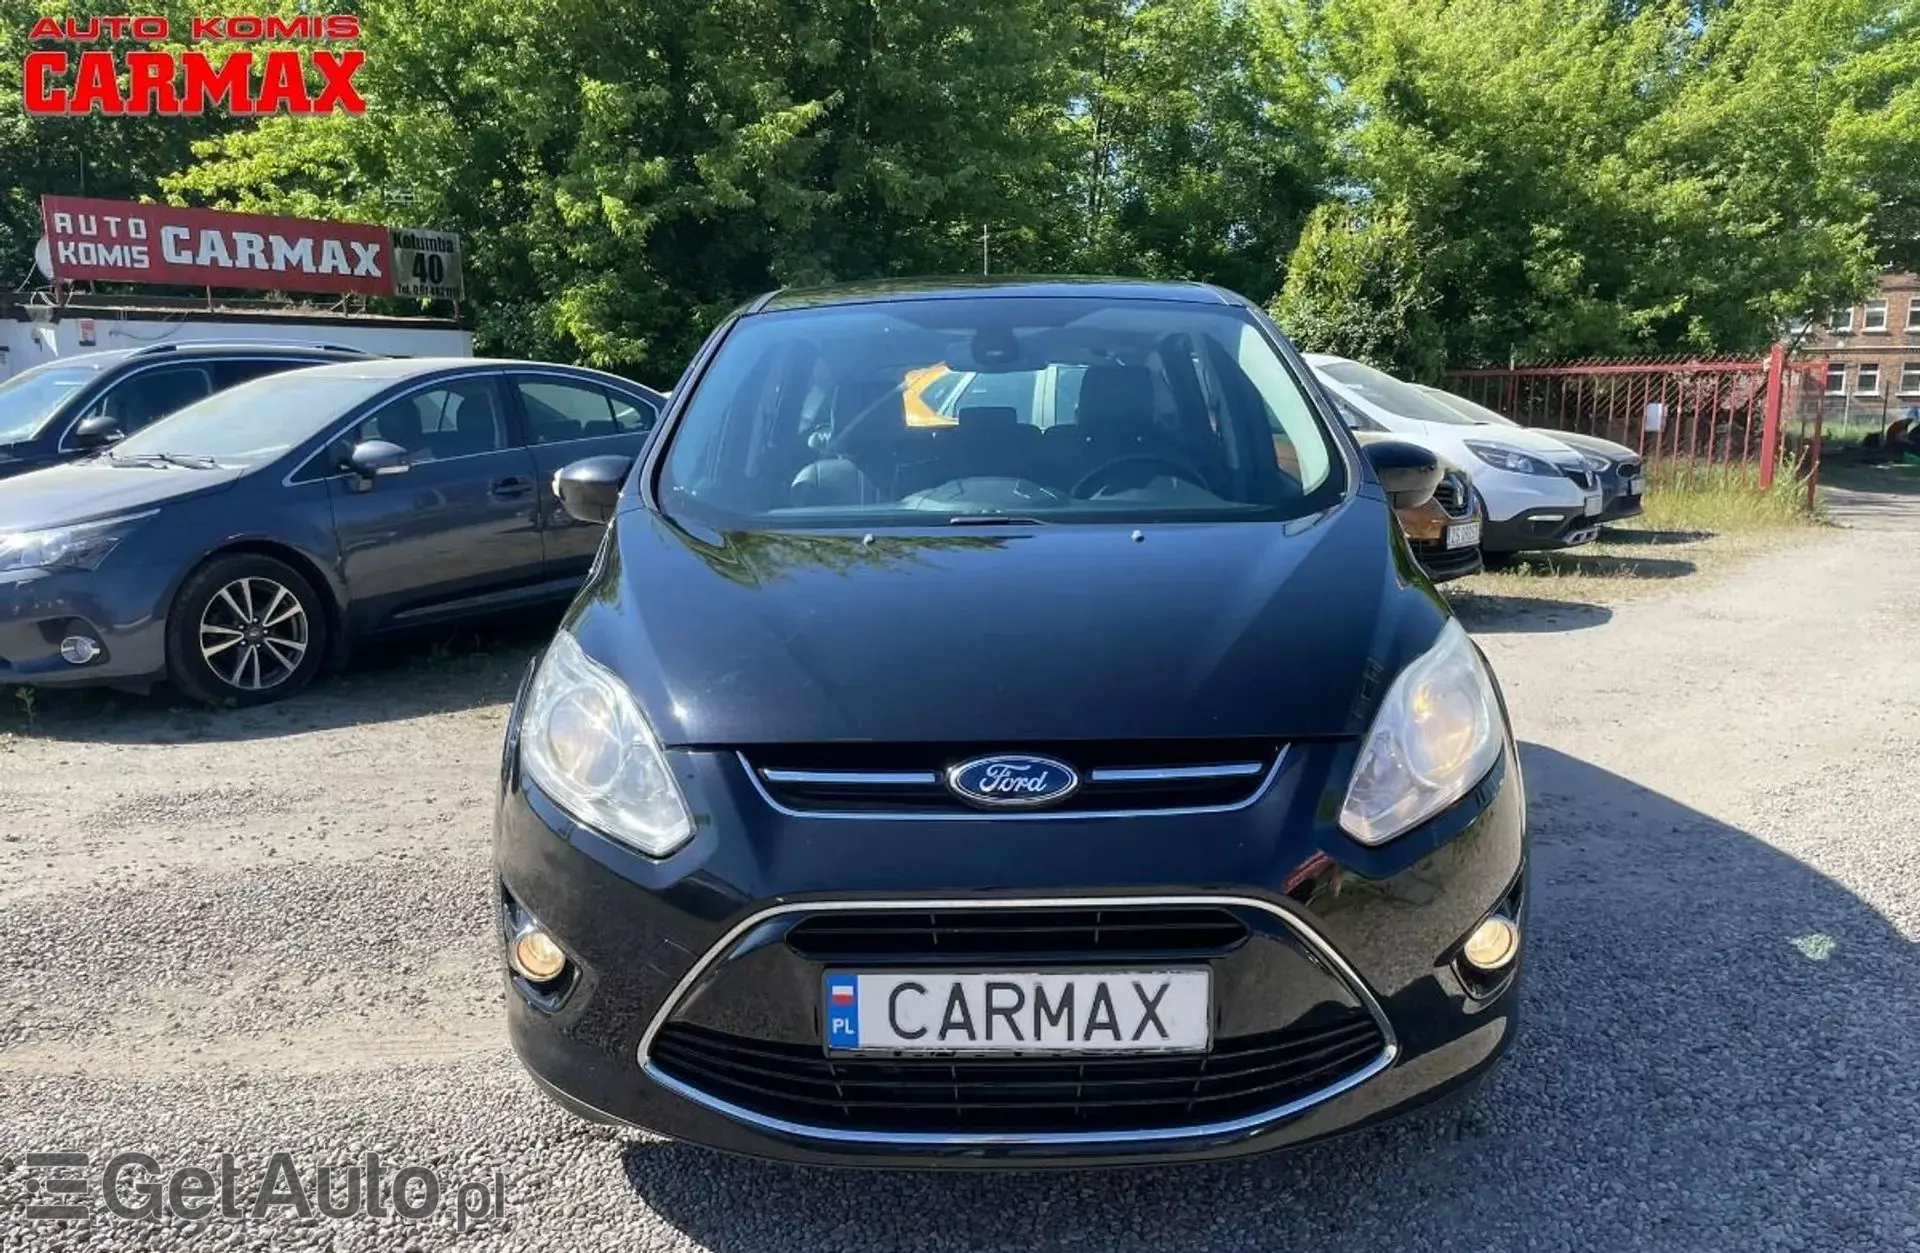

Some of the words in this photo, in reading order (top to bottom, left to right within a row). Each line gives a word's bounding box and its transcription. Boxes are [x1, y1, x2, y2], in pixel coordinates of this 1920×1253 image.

[54, 212, 147, 240] AUTO
[57, 241, 150, 269] KOMIS
[160, 225, 382, 278] CARMAX
[413, 252, 444, 284] 40
[979, 764, 1048, 792] Ford
[832, 1018, 854, 1034] PL
[888, 982, 1170, 1042] CARMAX
